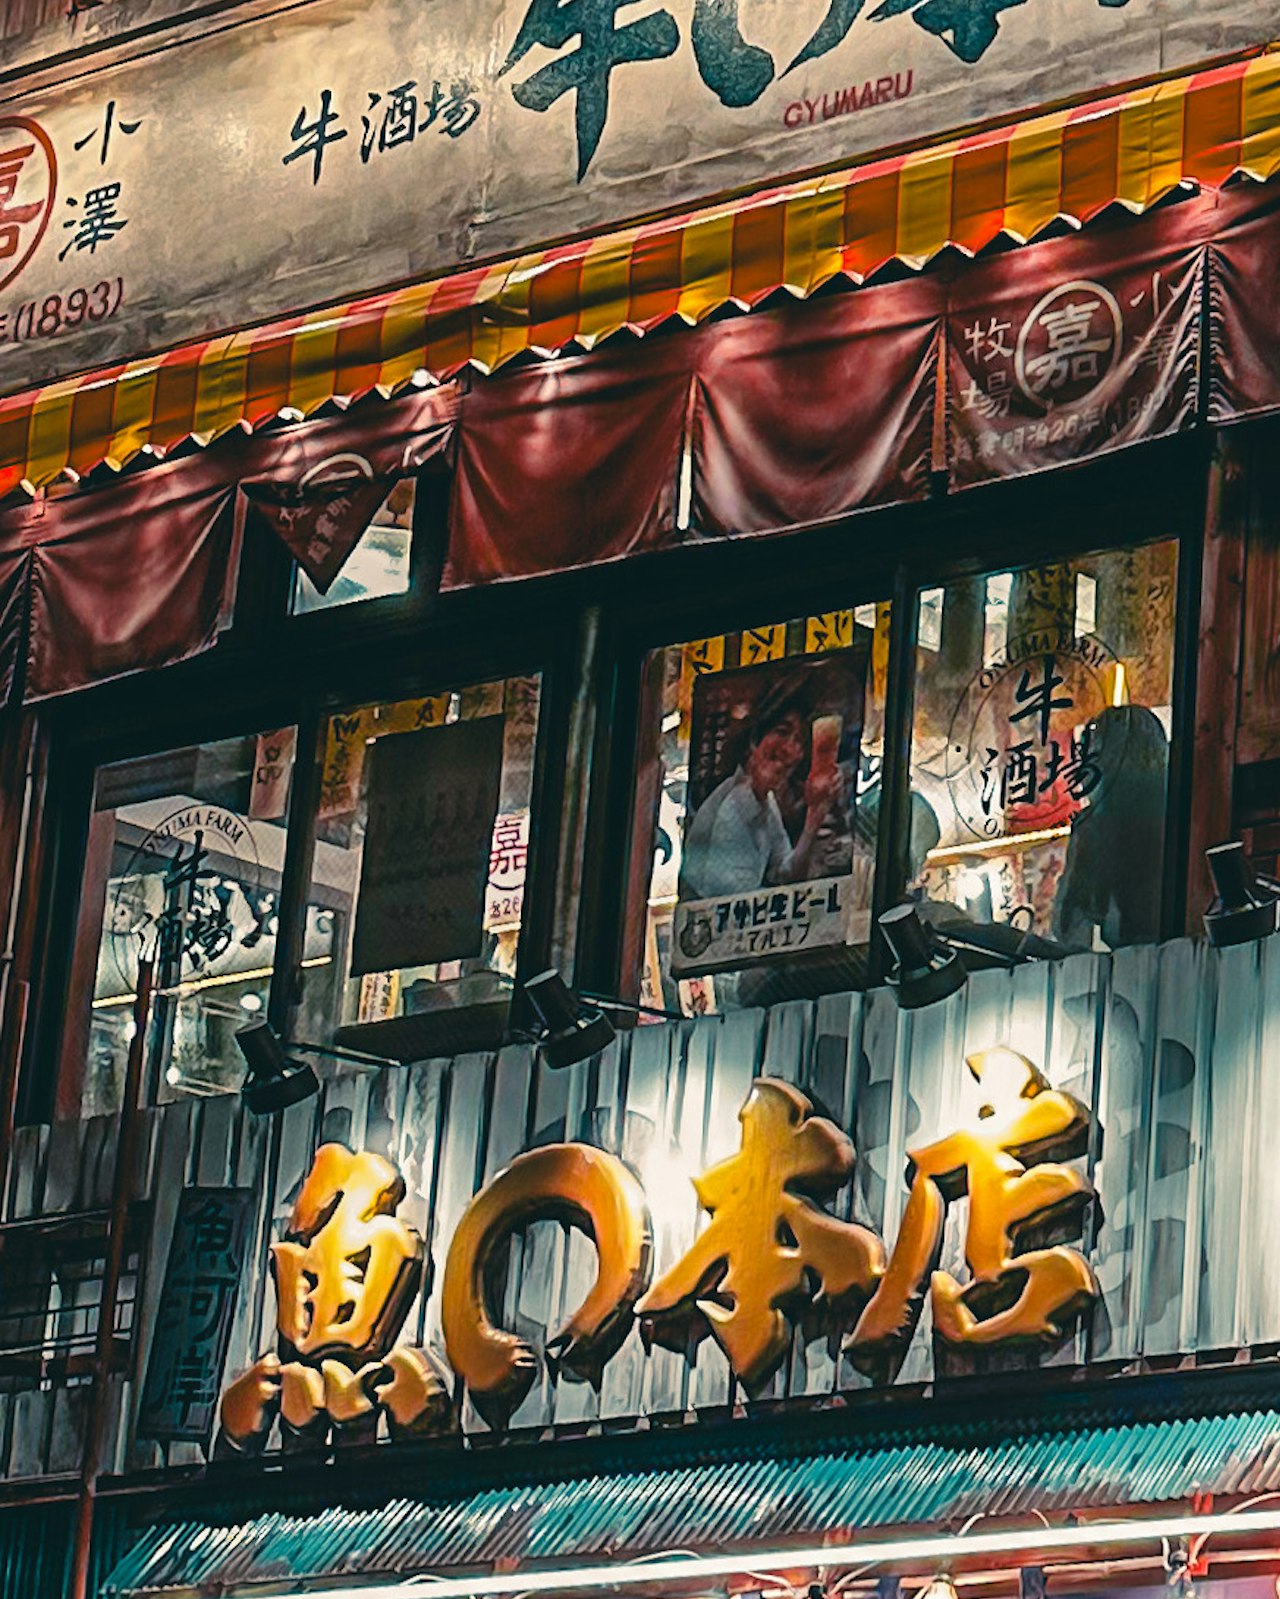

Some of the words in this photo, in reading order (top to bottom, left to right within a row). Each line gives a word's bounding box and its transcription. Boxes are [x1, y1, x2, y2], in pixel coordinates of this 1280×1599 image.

[281, 80, 482, 185] 牛酒場
[784, 70, 913, 128] GYUMARU
[57, 100, 142, 263] 小澤
[1009, 653, 1074, 747] 牛
[979, 740, 1103, 817] 酒場
[206, 810, 245, 845] FARM
